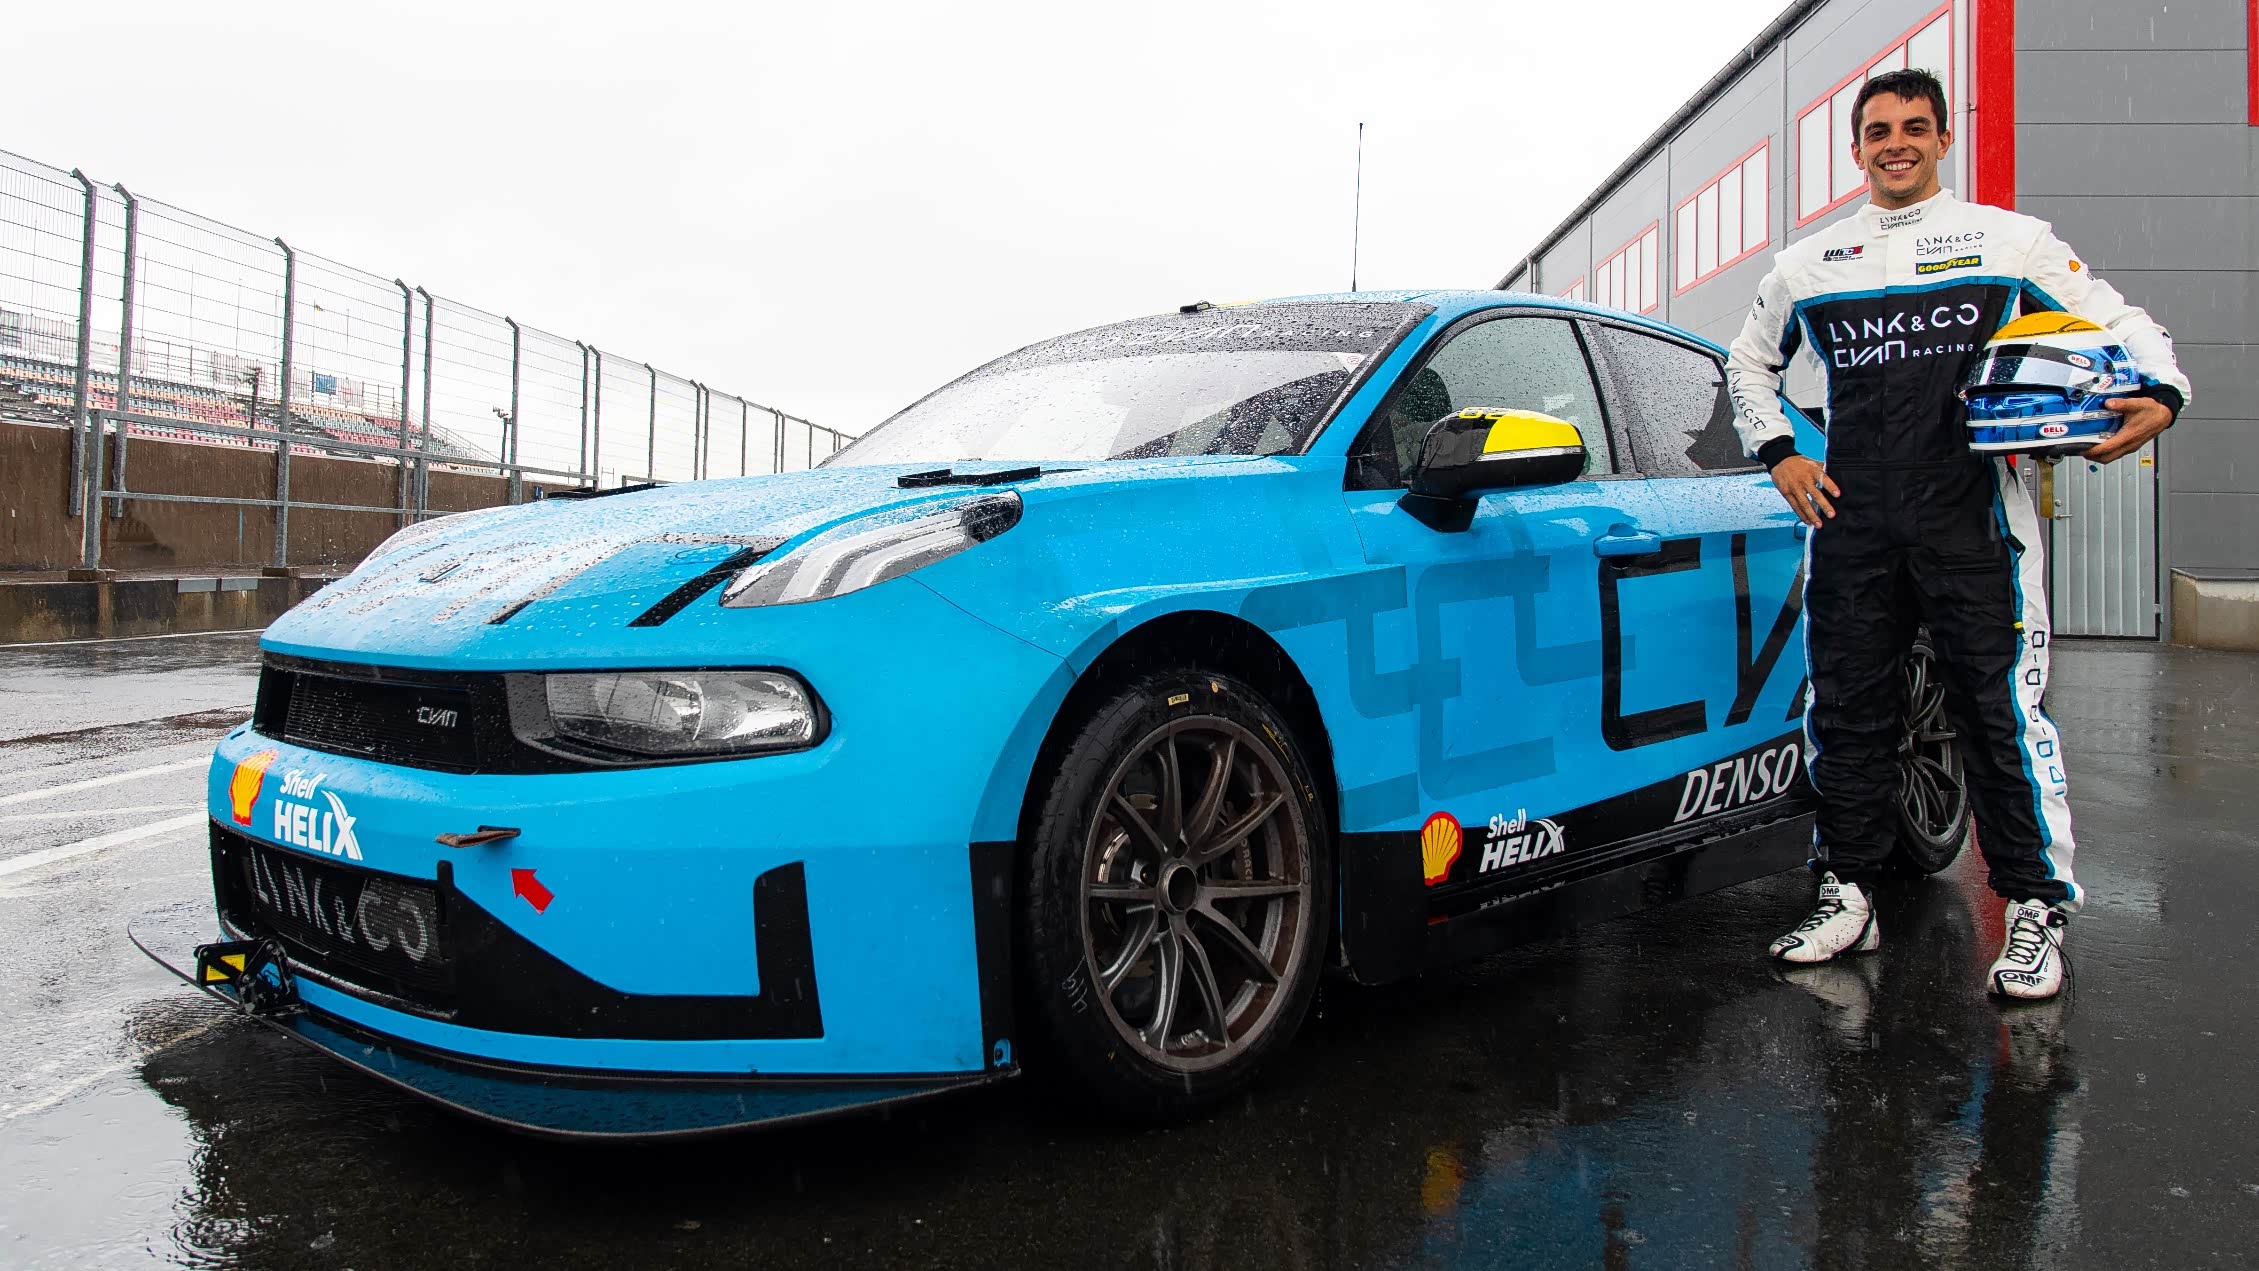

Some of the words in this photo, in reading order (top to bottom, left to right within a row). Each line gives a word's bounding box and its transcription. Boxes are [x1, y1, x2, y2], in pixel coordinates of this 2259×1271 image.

[1918, 257, 1979, 273] GOODYEAR
[1912, 343, 1974, 357] RACING
[2071, 355, 2087, 364] BELL
[280, 768, 328, 800] Shell
[1673, 743, 1799, 823] DENSO
[274, 789, 363, 861] HELIX
[1486, 807, 1527, 839] Shell
[1479, 818, 1565, 873] HELIX
[2017, 907, 2040, 919] OMP
